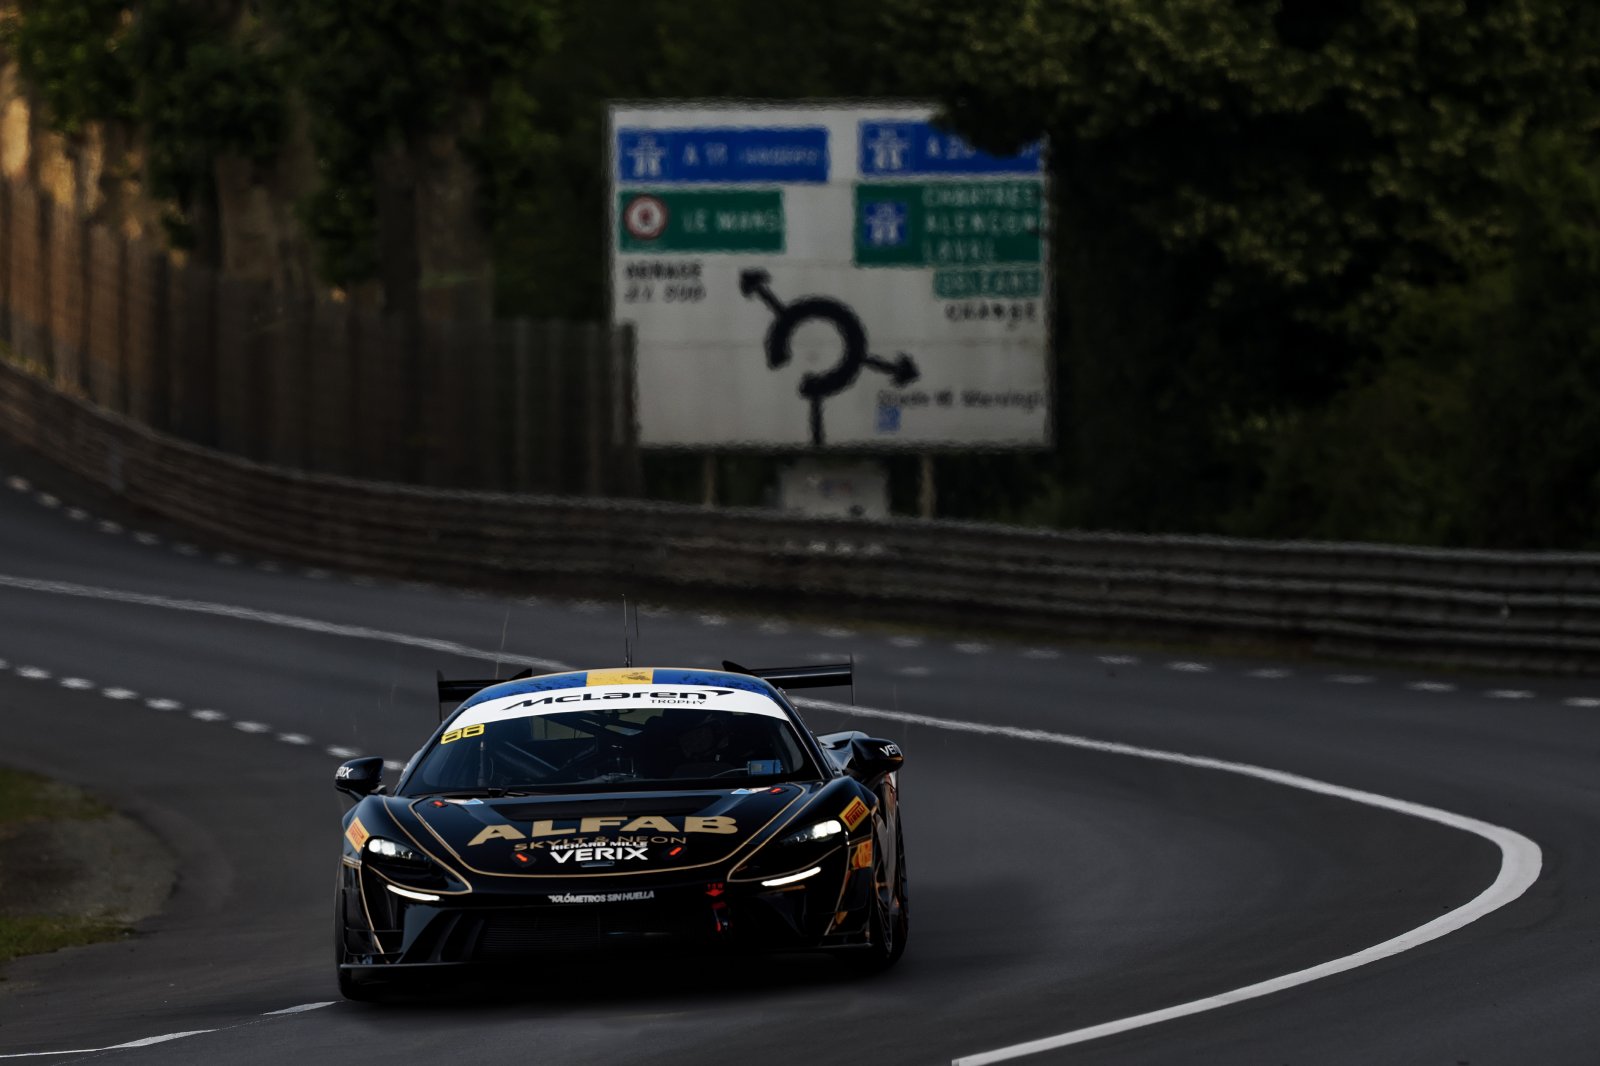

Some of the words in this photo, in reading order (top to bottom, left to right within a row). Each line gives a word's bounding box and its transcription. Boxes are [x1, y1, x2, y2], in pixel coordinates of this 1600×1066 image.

[441, 723, 485, 745] 88
[467, 815, 738, 846] ALFAB
[551, 841, 606, 850] RICHARD
[617, 835, 687, 844] NEON
[549, 847, 649, 864] VERIX
[607, 893, 622, 901] SIN
[622, 890, 654, 901] HUELLA
